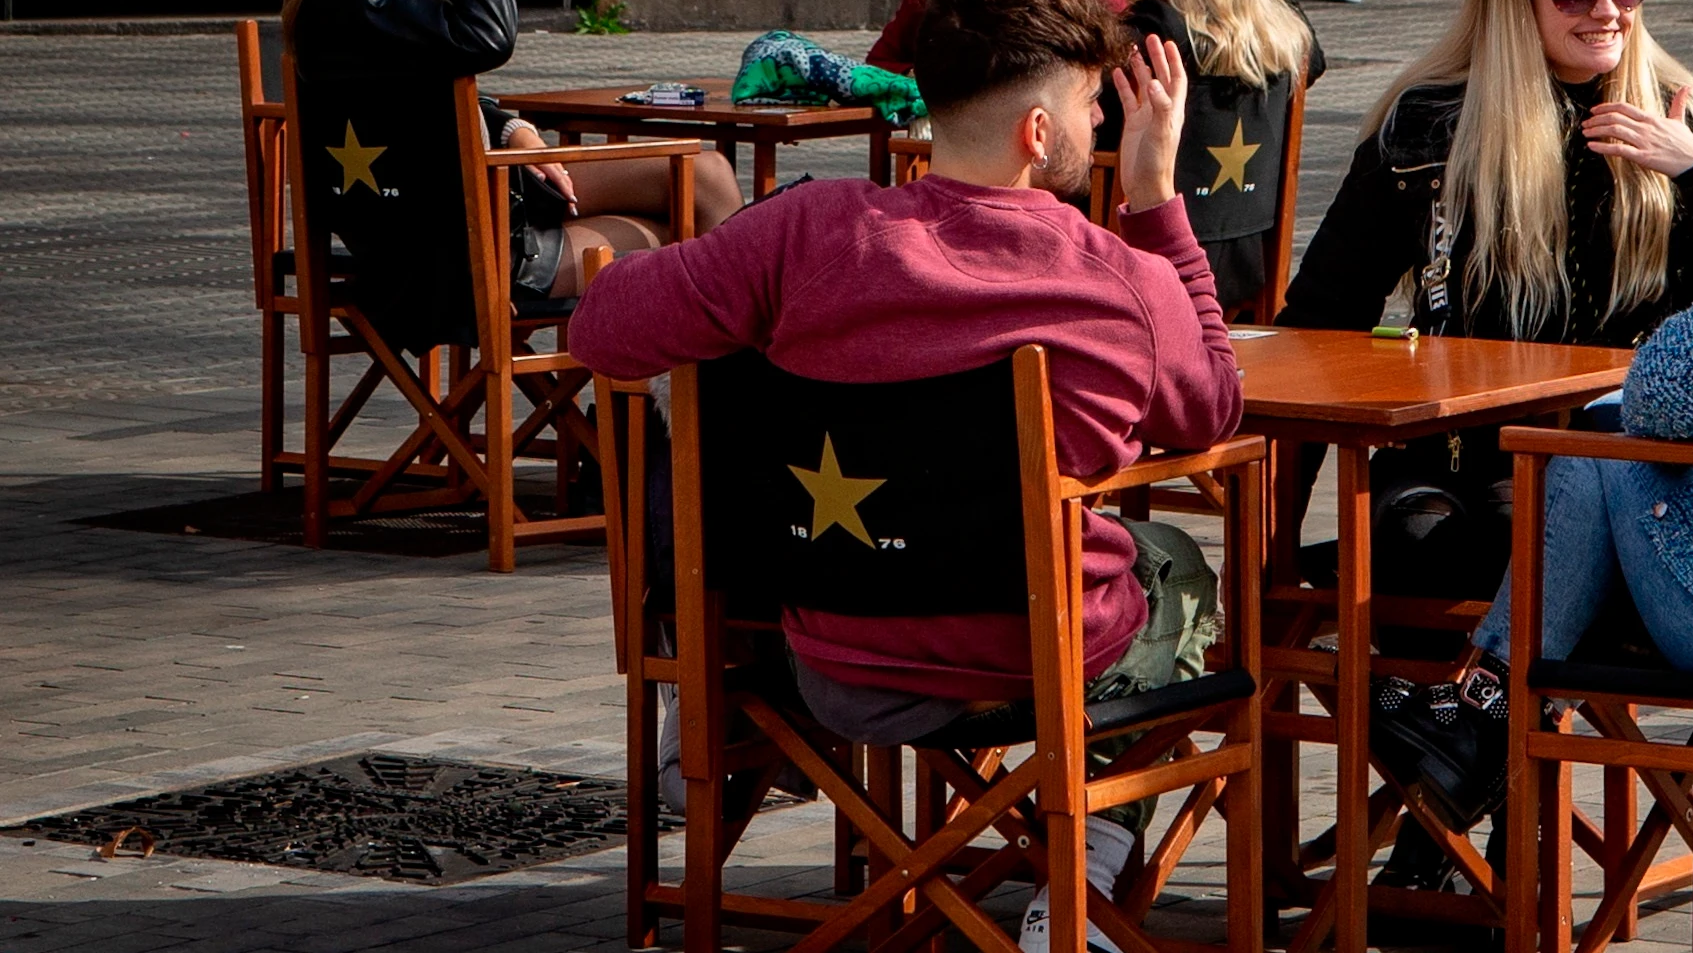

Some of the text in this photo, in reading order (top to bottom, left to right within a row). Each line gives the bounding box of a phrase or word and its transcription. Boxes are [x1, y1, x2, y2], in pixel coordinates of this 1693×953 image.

[382, 188, 400, 198] 76
[790, 524, 906, 550] 18 76
